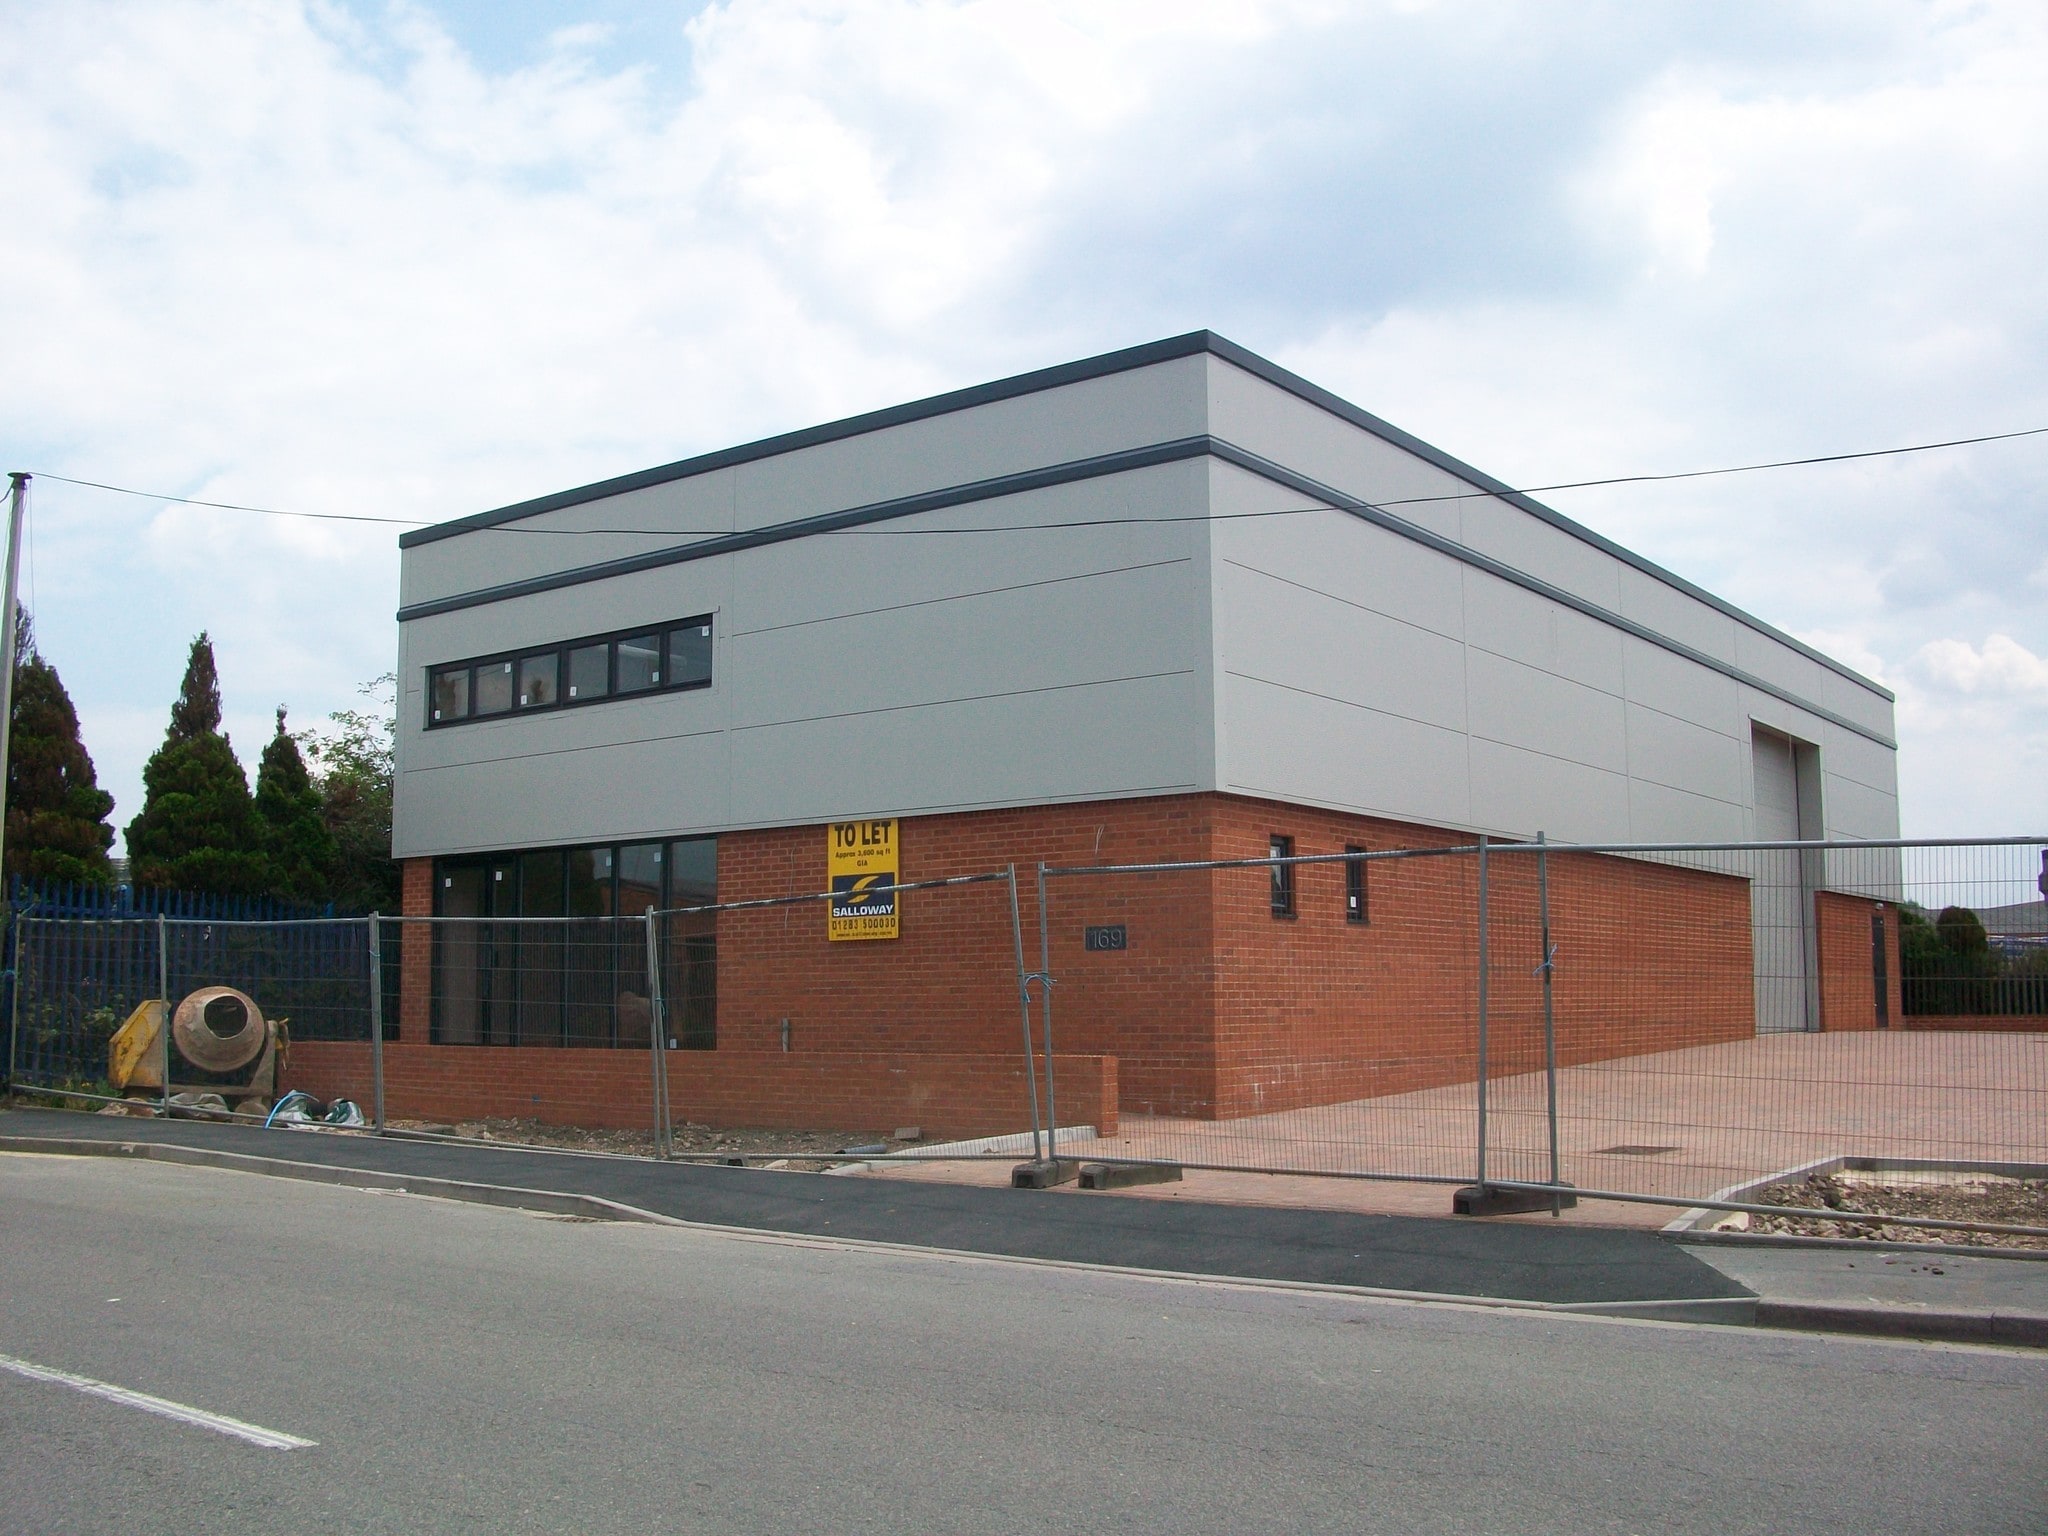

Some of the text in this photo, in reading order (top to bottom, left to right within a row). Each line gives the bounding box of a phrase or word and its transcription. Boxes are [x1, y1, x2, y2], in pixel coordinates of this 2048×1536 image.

[834, 821, 891, 847] TO LET
[835, 851, 855, 859] Approx
[833, 904, 894, 917] SALLOWAY
[832, 918, 896, 930] 01283 500030
[1090, 929, 1122, 948] 169
